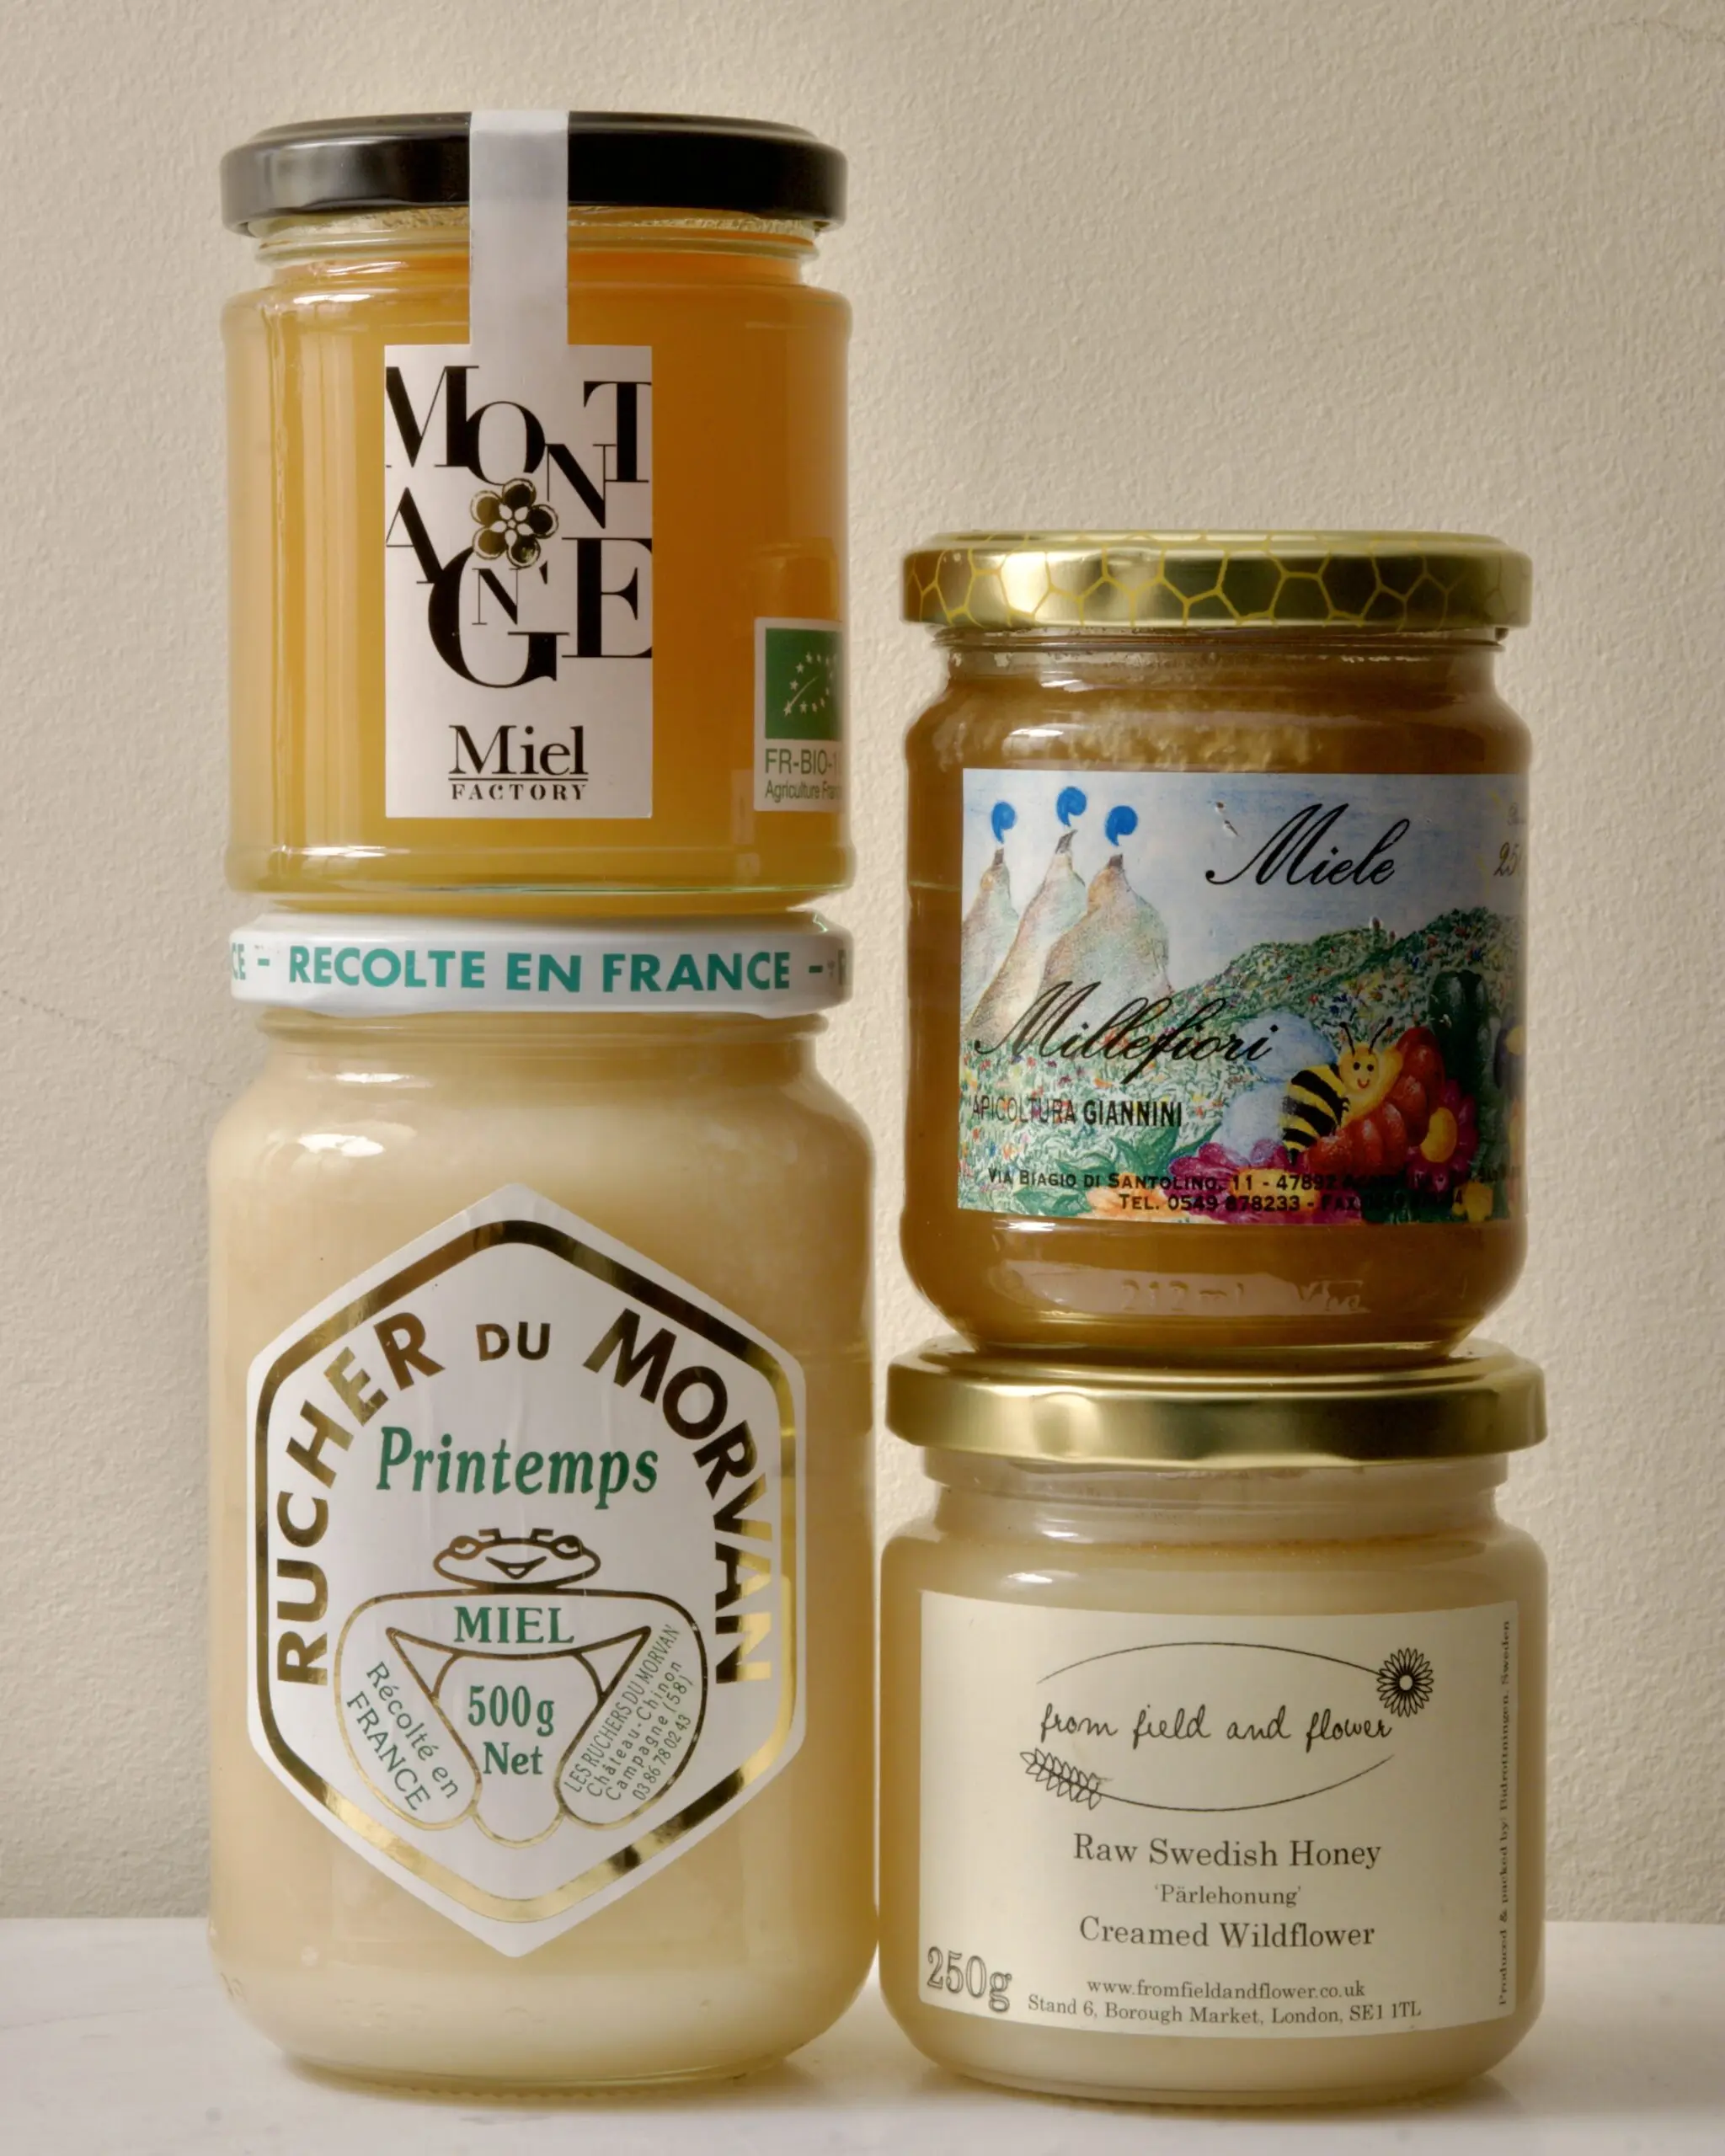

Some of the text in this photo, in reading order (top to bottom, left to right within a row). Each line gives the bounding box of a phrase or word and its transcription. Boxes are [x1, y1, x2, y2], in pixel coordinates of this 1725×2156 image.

[448, 725, 588, 776] Miel
[451, 783, 586, 800] FACTORY
[765, 780, 820, 803] Agriculture
[1205, 803, 1410, 886] Miele
[289, 945, 484, 988] RECOLTE
[505, 953, 582, 992] EN
[602, 952, 791, 992] FRANCE
[974, 981, 1279, 1085] Millefiori
[971, 1095, 1183, 1127] APICOLTURA GIANNINI
[1019, 1170, 1076, 1187] BIAGIO
[1232, 1174, 1253, 1191] 11
[1119, 1193, 1160, 1210] TEL.
[1167, 1195, 1219, 1211] 0549
[1226, 1195, 1300, 1211] 878233
[376, 1426, 660, 1510] Printemps
[276, 1307, 773, 1685] RUCHER DU MORVAN
[453, 1606, 574, 1644] MIEL
[1500, 1620, 1510, 1686] Sweden
[366, 1661, 459, 1799] Récolté en
[467, 1684, 555, 1737] 500g
[563, 1624, 681, 1793] LES RUCHERS DU MORVAN
[1040, 1702, 1393, 1754] from field and flower
[346, 1691, 431, 1811] FRANCE
[483, 1741, 543, 1775] Net
[606, 1715, 668, 1801] Campagne
[633, 1713, 692, 1801] 03 86 78 02 43
[1074, 1833, 1382, 1870] Raw Swedish Honey
[1499, 1846, 1510, 1903] packed
[1080, 1916, 1375, 1948] Creamed Wildflower
[927, 1946, 1012, 2013] 250g
[1087, 1978, 1366, 1999] www.fromfieldandflower.co.uk
[1499, 1929, 1508, 2006] Produced
[1028, 1993, 1423, 2026] Stand 6, Borough Market, London, SE1 1TL
